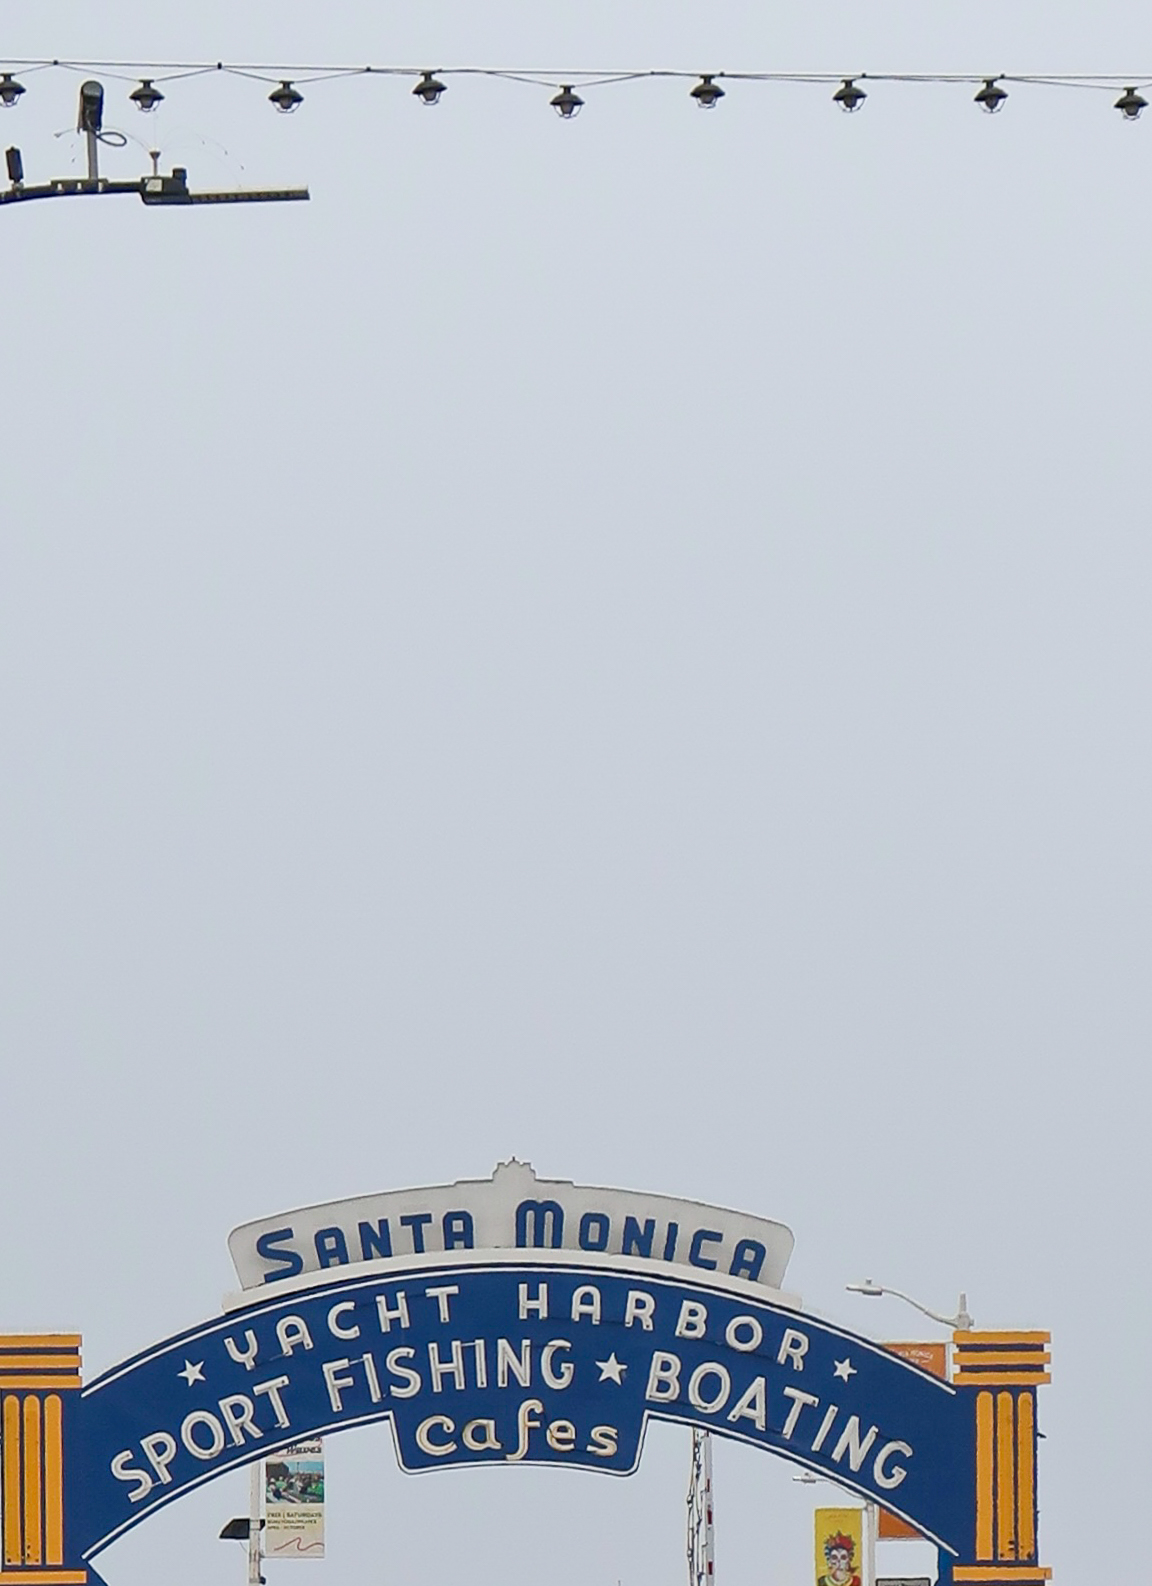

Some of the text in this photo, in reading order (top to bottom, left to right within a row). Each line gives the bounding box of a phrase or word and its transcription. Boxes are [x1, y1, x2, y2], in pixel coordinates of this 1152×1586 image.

[256, 1199, 767, 1283] SANTA MONICA
[224, 1282, 811, 1372] YACHT HARBOR
[110, 1338, 914, 1504] SPORT FISHING BOATING
[415, 1398, 619, 1462] cafes
